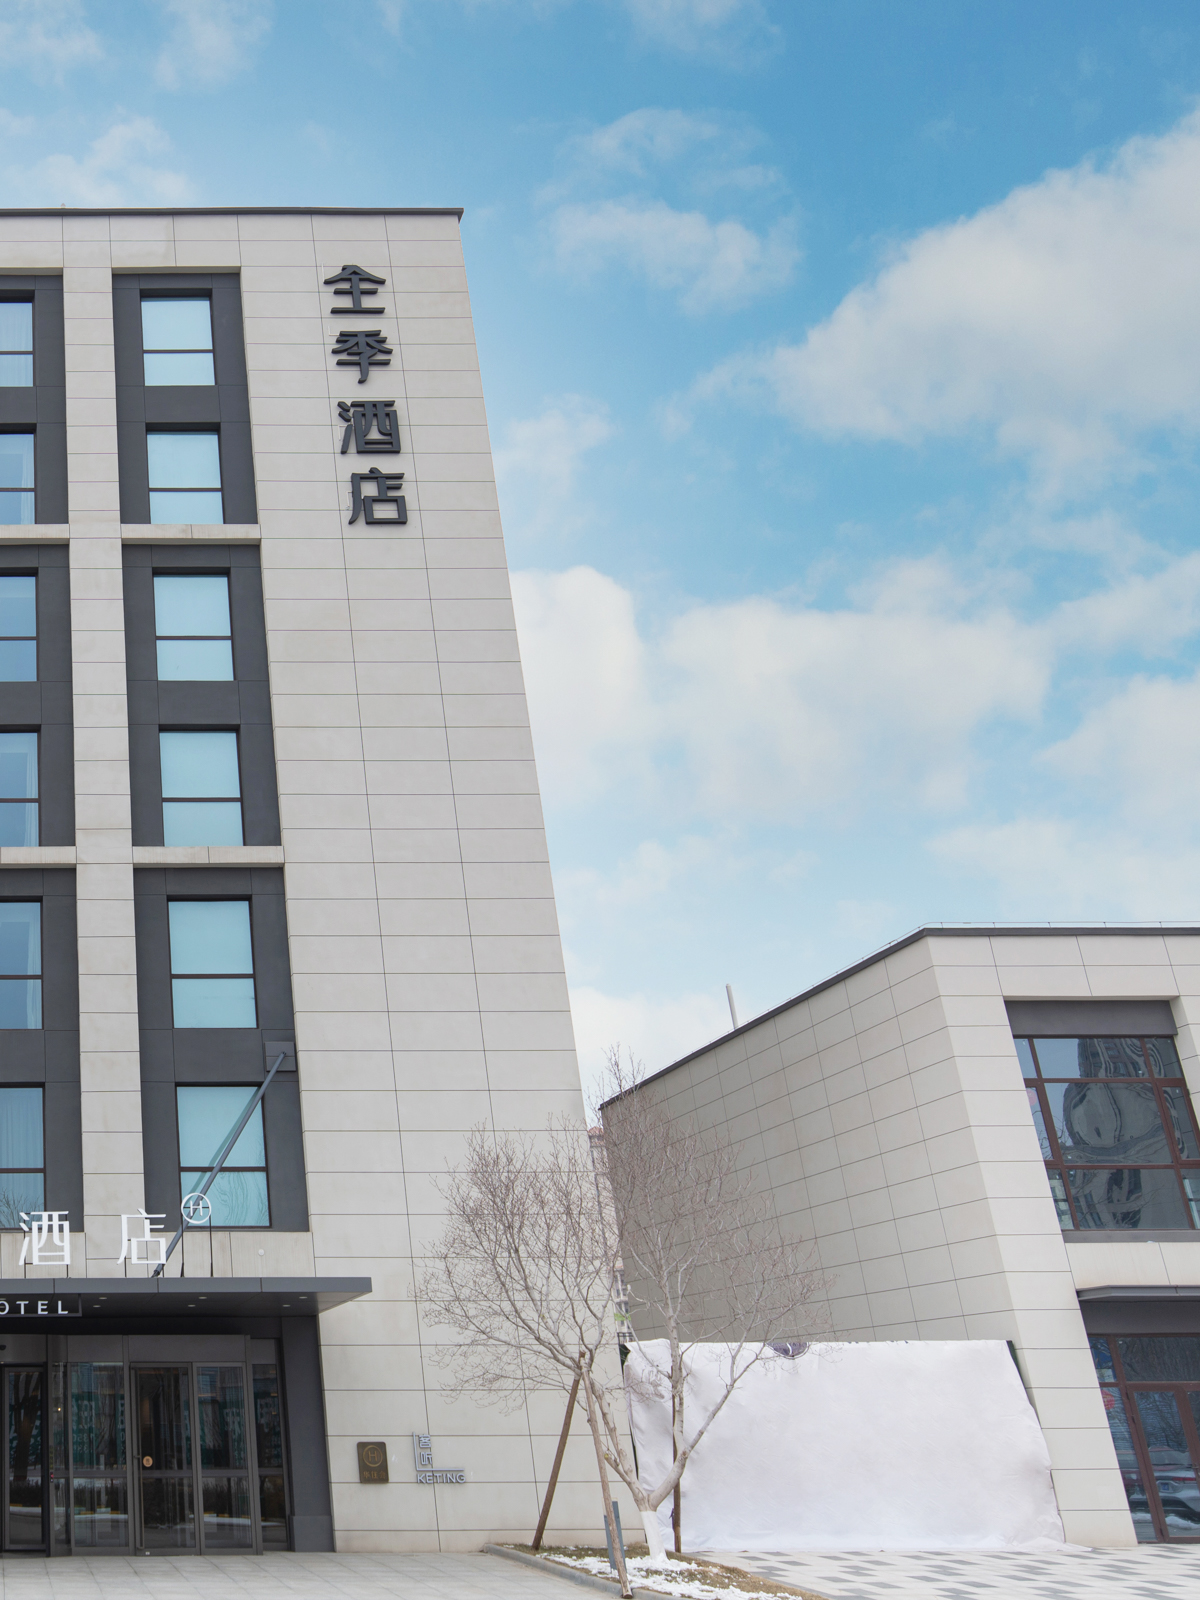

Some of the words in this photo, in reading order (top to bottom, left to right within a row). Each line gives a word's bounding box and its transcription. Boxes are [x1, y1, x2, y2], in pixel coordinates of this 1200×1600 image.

[323, 264, 408, 525] 全季酒店
[417, 1472, 466, 1484] KETING
